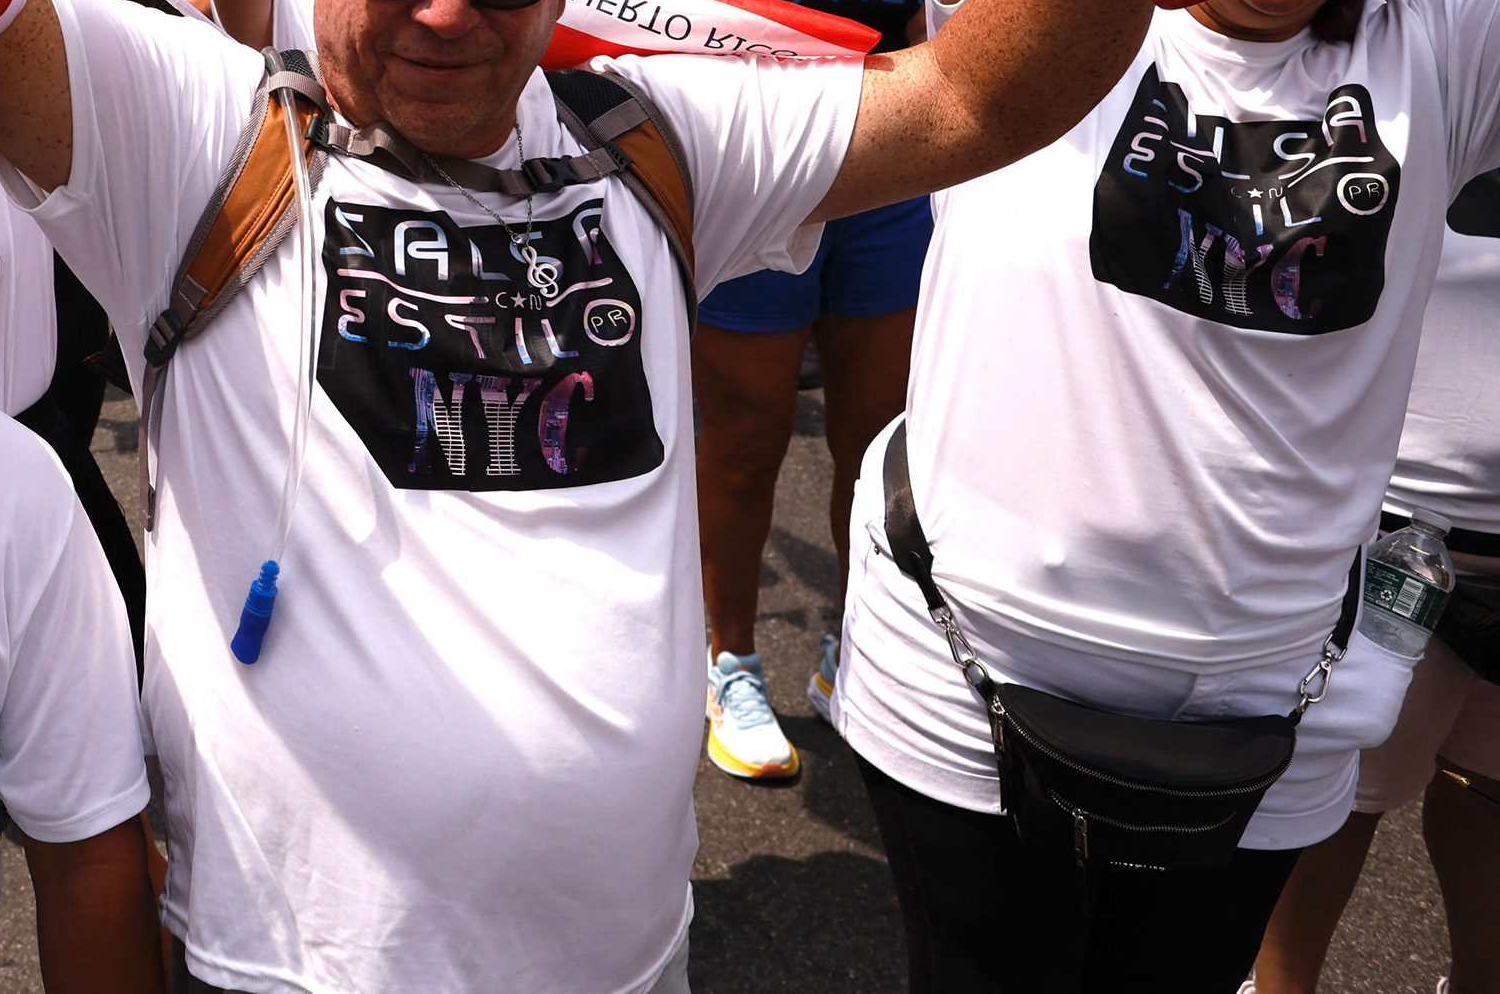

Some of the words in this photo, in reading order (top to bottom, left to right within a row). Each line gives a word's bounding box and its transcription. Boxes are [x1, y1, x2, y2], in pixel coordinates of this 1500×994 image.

[1123, 132, 1389, 236] ESILO
[1163, 207, 1328, 319] NYC
[337, 289, 636, 365] ESTILO
[590, 309, 628, 333] PR
[407, 367, 595, 477] NYC
